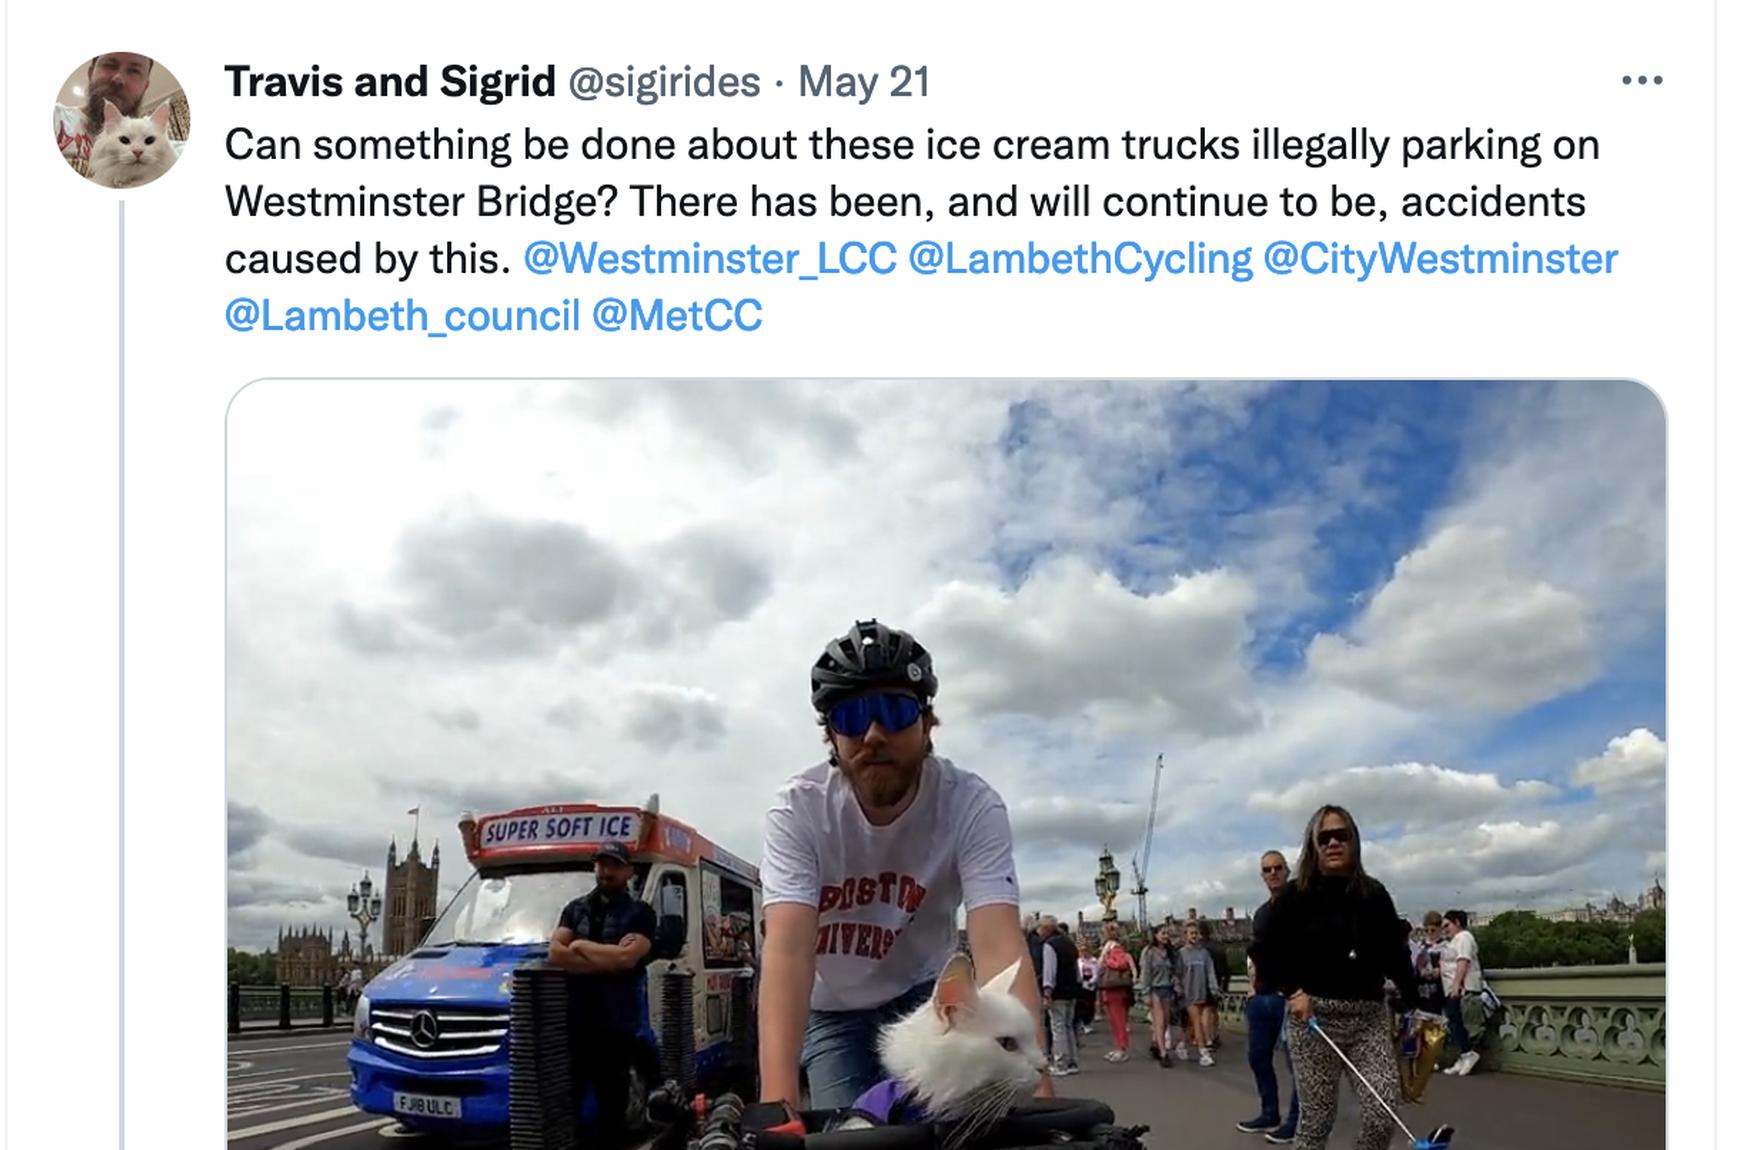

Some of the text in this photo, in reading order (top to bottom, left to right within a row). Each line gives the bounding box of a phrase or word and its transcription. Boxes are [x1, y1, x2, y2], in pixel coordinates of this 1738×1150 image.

[486, 816, 631, 842] SUPER SOFT ICE
